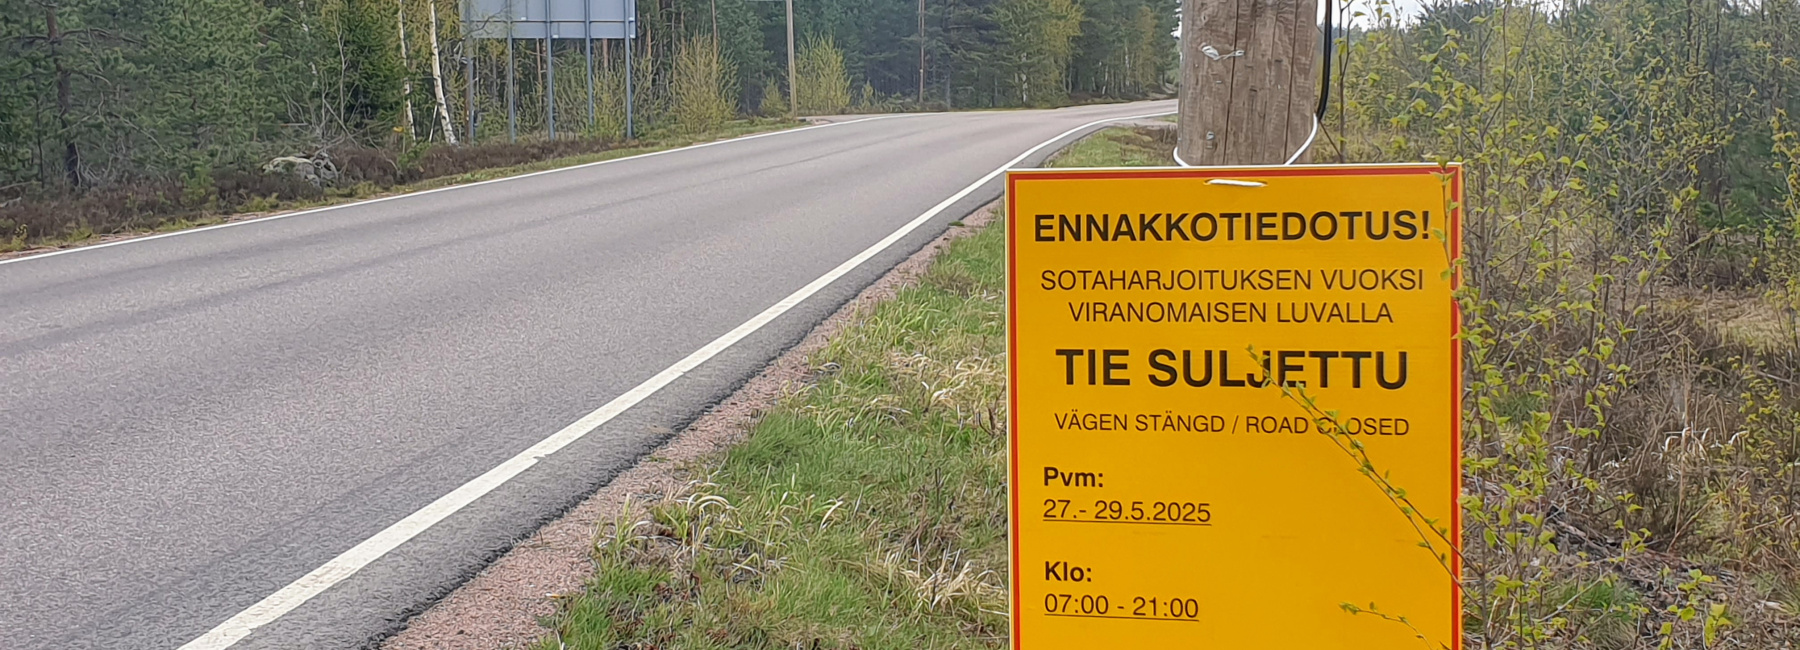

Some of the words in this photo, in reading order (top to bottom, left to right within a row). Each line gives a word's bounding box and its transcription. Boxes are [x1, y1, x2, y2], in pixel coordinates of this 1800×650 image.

[1034, 210, 1430, 242] ENNAKKOTIEDOTUS!
[1040, 269, 1312, 292] SOTAHARJOITUKSEN
[1320, 269, 1424, 291] VUOKSI
[1068, 301, 1268, 323] VIRANOMAISEN
[1276, 302, 1394, 324] LUVALLA
[1055, 348, 1131, 386] TIE
[1147, 348, 1408, 390] SULJETTU
[1054, 409, 1128, 431] VÄGEN
[1134, 410, 1225, 433] STÄNGD
[1231, 415, 1240, 435] /
[1246, 416, 1309, 434] ROAD
[1043, 466, 1104, 488] Pvm:
[1094, 501, 1212, 523] 29.5.2025
[1044, 561, 1092, 583] Klo:
[1044, 593, 1110, 615] 07:00
[1132, 597, 1199, 618] 21:00
